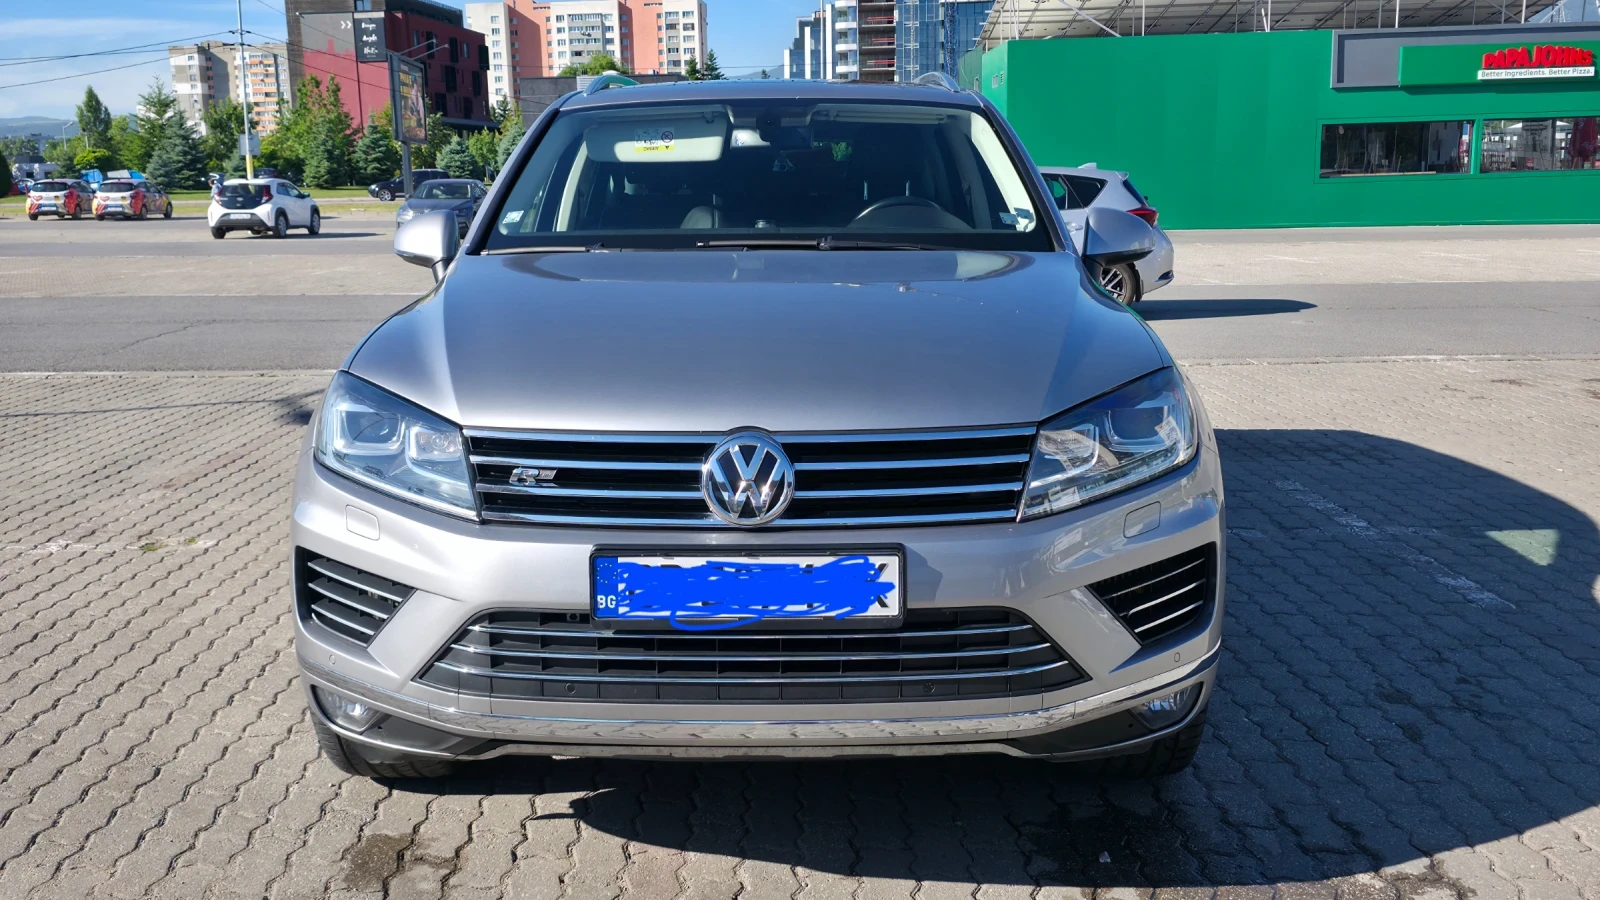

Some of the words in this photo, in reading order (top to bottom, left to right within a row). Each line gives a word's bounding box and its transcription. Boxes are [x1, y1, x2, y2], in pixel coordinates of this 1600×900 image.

[1482, 46, 1530, 69] PAPA
[1530, 45, 1593, 67] JOHNS
[1481, 70, 1503, 78] Better
[1548, 68, 1571, 76] Better
[1571, 67, 1593, 75] Pizza.
[706, 437, 790, 523] VW
[597, 594, 616, 609] BG
